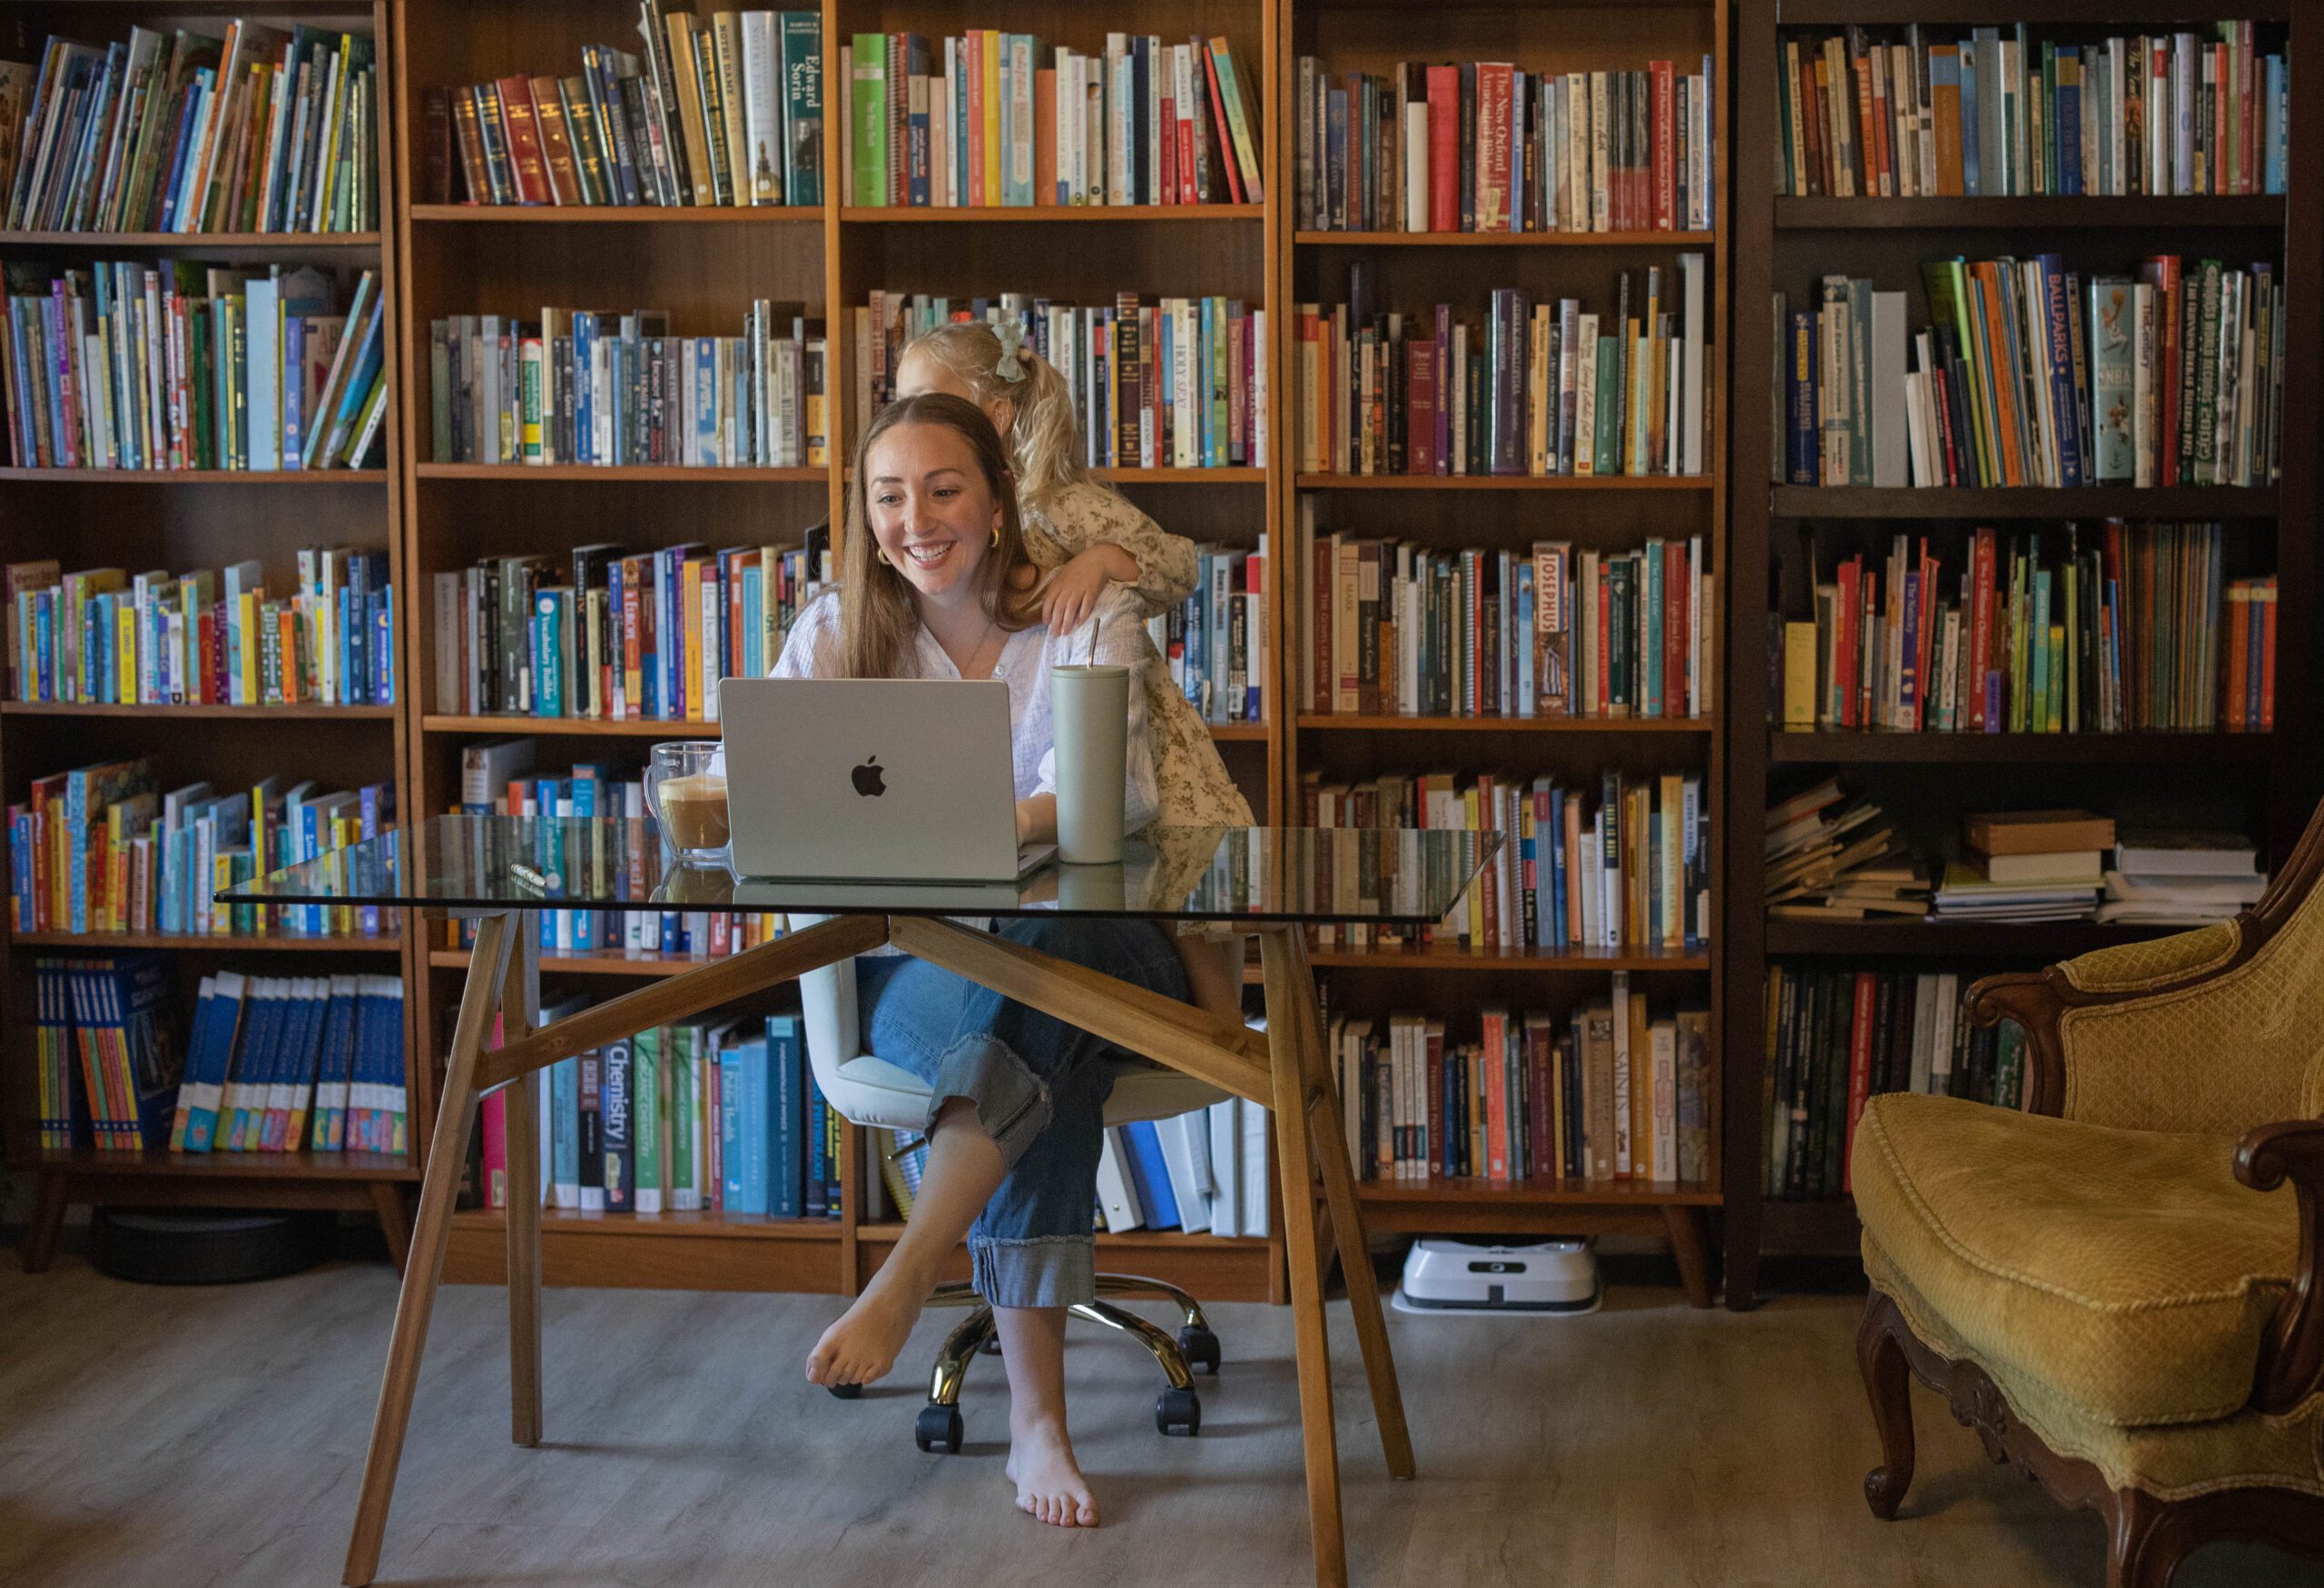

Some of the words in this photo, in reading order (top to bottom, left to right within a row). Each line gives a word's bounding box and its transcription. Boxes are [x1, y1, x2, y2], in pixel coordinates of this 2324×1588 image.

[717, 25, 730, 60] NOTRE
[724, 64, 734, 96] DAME
[790, 63, 806, 101] Sorin
[804, 55, 822, 108] Edward
[1179, 55, 1187, 109] BOUNDARIES
[1495, 73, 1508, 94] The
[1856, 64, 1871, 115] SHAKEN
[1482, 71, 1494, 138] Annotated
[1495, 98, 1508, 124] New
[1692, 102, 1701, 147] Rediscover
[1482, 140, 1494, 169] Bible
[1495, 126, 1508, 172] Oxford
[1692, 151, 1702, 200] Catholicism
[2048, 274, 2068, 363] BALLPARKS
[1176, 344, 1187, 378] HOLY
[1835, 333, 1843, 365] Estate
[667, 359, 676, 380] JANE
[1581, 363, 1593, 389] Living
[2105, 367, 2132, 385] NBA
[639, 375, 648, 409] HOMER
[1176, 380, 1187, 409] SEX!
[1582, 390, 1593, 418] Catholic
[640, 412, 648, 424] the
[1143, 411, 1151, 445] LOZANO
[1979, 562, 1988, 578] The
[704, 586, 716, 613] How
[1541, 557, 1556, 631] JOSEPHUS
[1905, 583, 1916, 601] The
[1977, 580, 1988, 618] 5-Minute
[1904, 602, 1915, 635] Nativity
[540, 616, 551, 666] Vocabulary
[1976, 620, 1987, 663] Christmas
[542, 667, 552, 701] Builder
[1974, 665, 1985, 694] Stories
[607, 1046, 628, 1139] Chemistry
[638, 1055, 650, 1102] ORGANIC
[678, 1068, 687, 1103] ORGANIC
[724, 1071, 734, 1103] Public
[1615, 1050, 1630, 1111] SAINTS
[639, 1102, 650, 1159] CHEMISTRY
[679, 1103, 688, 1149] CHEMISTRY
[724, 1107, 734, 1142] Health
[812, 1104, 824, 1182] PHYSIOLOGY
